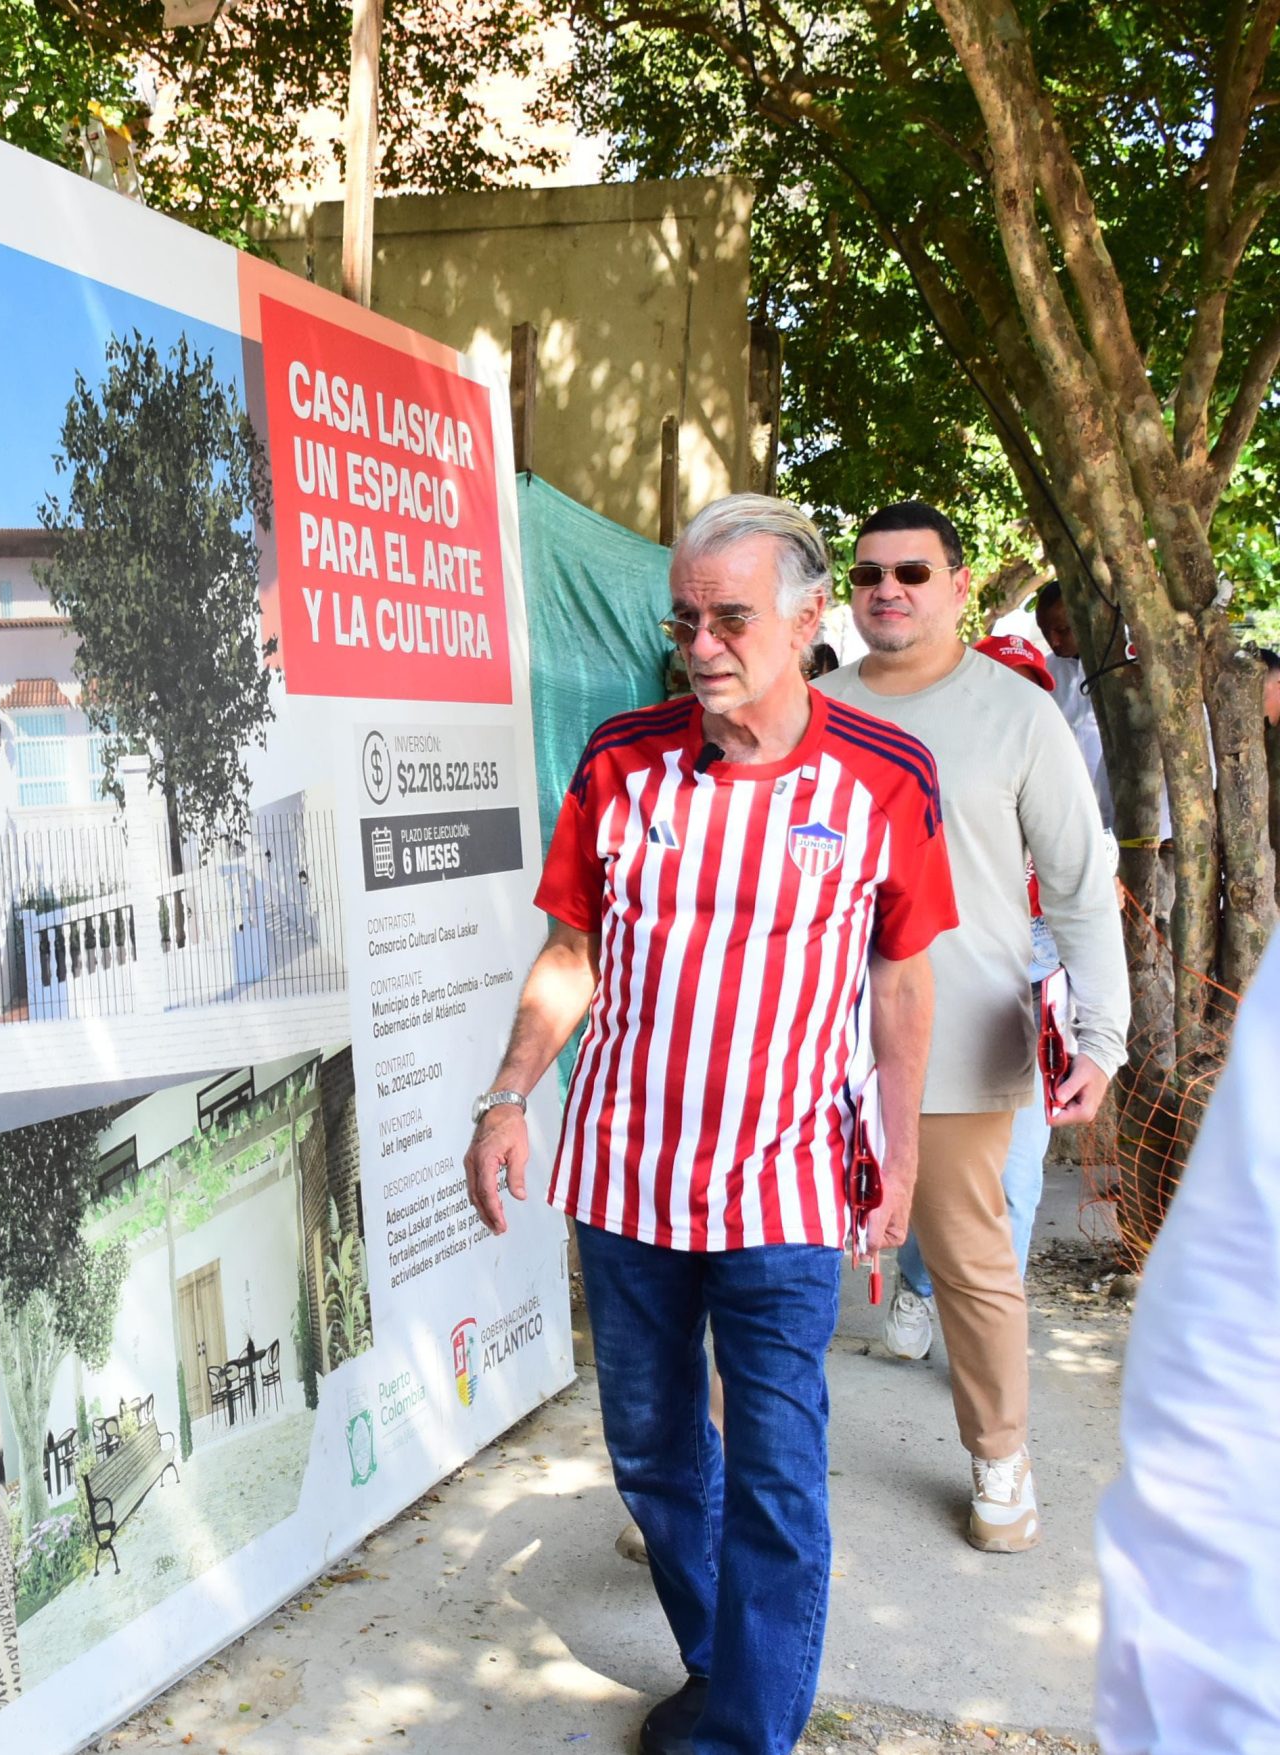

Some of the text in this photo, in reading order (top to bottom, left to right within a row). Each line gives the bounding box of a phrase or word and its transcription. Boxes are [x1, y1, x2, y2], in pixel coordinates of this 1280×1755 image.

[288, 361, 474, 471] CASA LASKAR
[293, 436, 460, 529] UN ESPACIO
[300, 512, 484, 596] PARA EL ARTE
[302, 587, 493, 660] Y LA CULTURA
[397, 760, 498, 798] $2.218.522.535
[401, 828, 423, 843] PLAZO
[424, 827, 433, 841] DE
[798, 839, 834, 851] JUNIOR
[402, 842, 460, 875] 6 MESES
[367, 912, 416, 935] CONTRATISTA
[368, 922, 479, 957] Consorcio Cultural Casa Laskar
[370, 970, 423, 996] CONTRATANTE
[372, 994, 409, 1018] Municipio
[411, 992, 420, 1007] de
[421, 986, 446, 1004] Puerto
[447, 977, 479, 998] Colombia
[484, 968, 513, 987] Convenio
[372, 1000, 467, 1038] Gobernación del Atlántico
[375, 1051, 415, 1078] CONTRATO
[392, 1062, 443, 1093] 20241223-001
[381, 1126, 433, 1158] Jet Ingeniería
[434, 1156, 455, 1176] OBRA
[386, 1178, 467, 1226] Adecuación y dotación
[387, 1230, 407, 1247] Casa
[408, 1214, 432, 1236] Laskar
[434, 1197, 468, 1223] destinado
[389, 1228, 446, 1268] fortalecimiento
[446, 1222, 456, 1237] de
[457, 1218, 467, 1232] las
[391, 1255, 433, 1288] actividades
[528, 1295, 541, 1312] DEL
[483, 1313, 543, 1374] ATLÁNTICO
[379, 1371, 410, 1403] Puerto
[381, 1385, 425, 1425] Colombia
